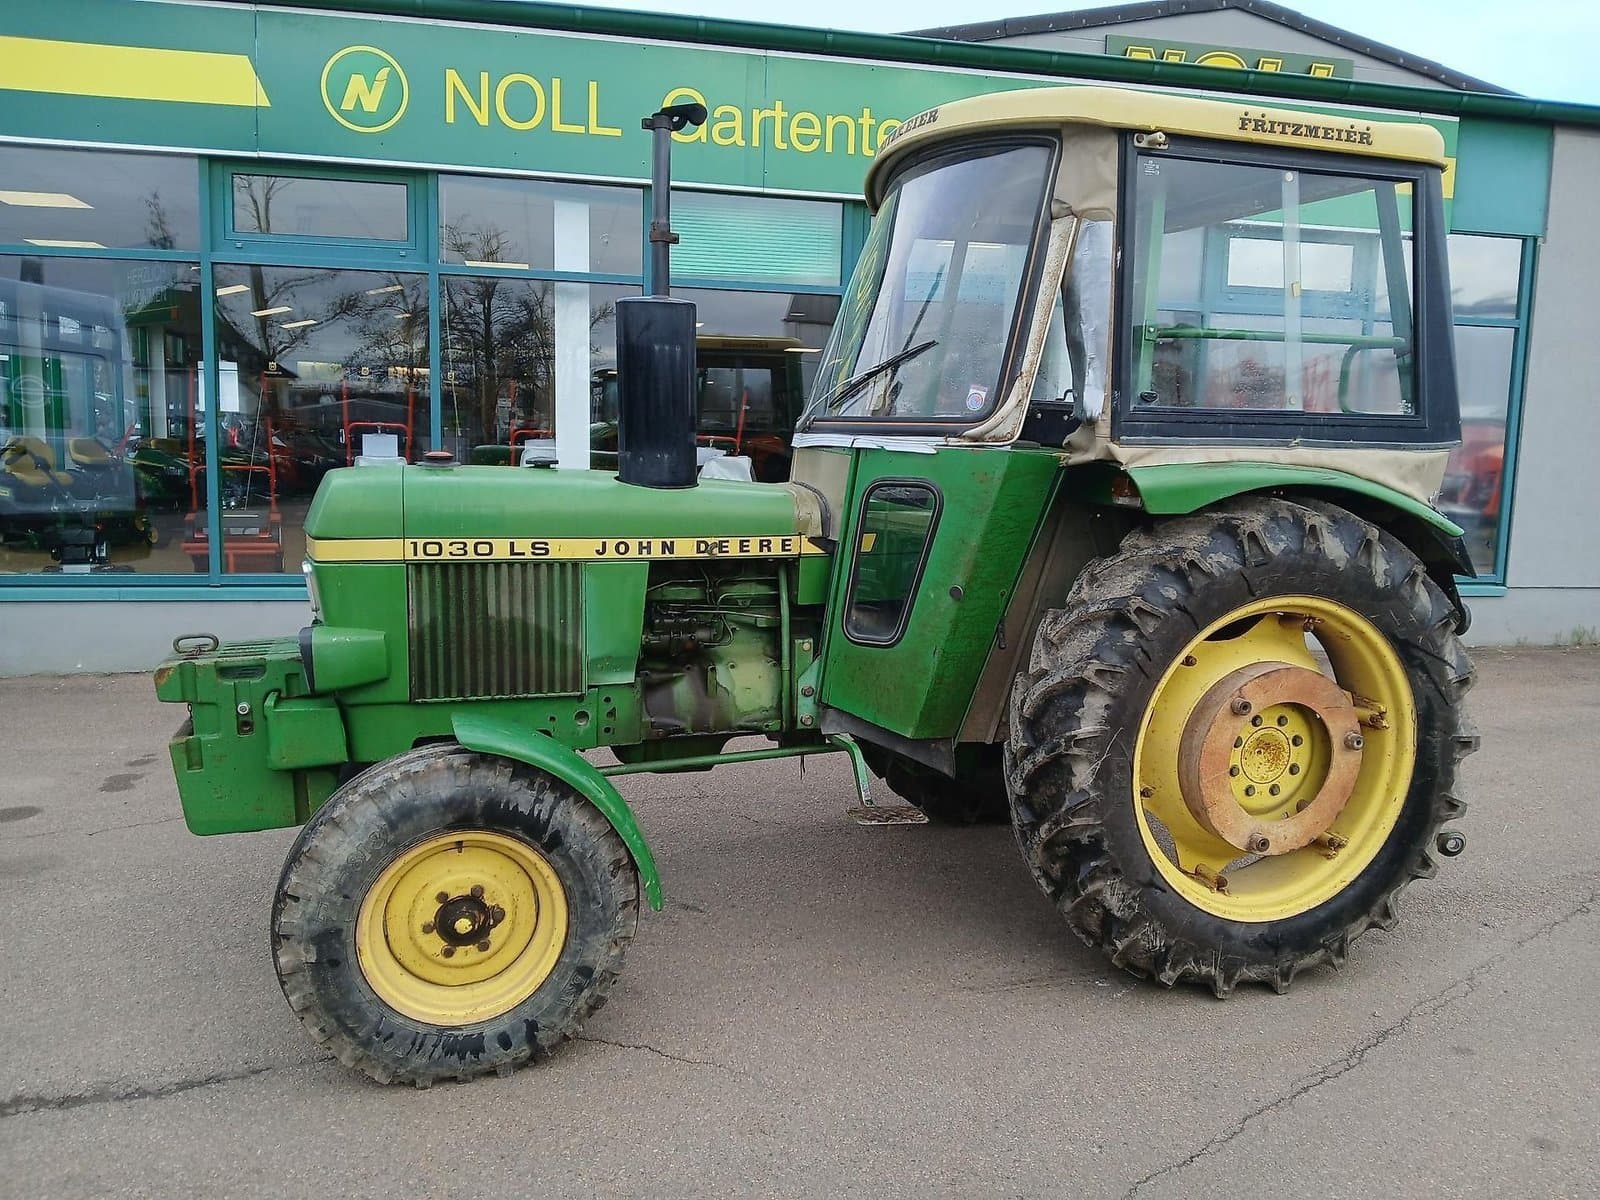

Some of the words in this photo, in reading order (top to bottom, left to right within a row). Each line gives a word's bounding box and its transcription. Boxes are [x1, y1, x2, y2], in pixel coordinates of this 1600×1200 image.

[445, 68, 623, 137] NOLL
[1238, 116, 1373, 146] FRITZMEIER
[409, 541, 495, 557] 1030
[509, 541, 550, 557] LS
[595, 540, 676, 556] JOHN
[695, 538, 793, 554] DEERE
